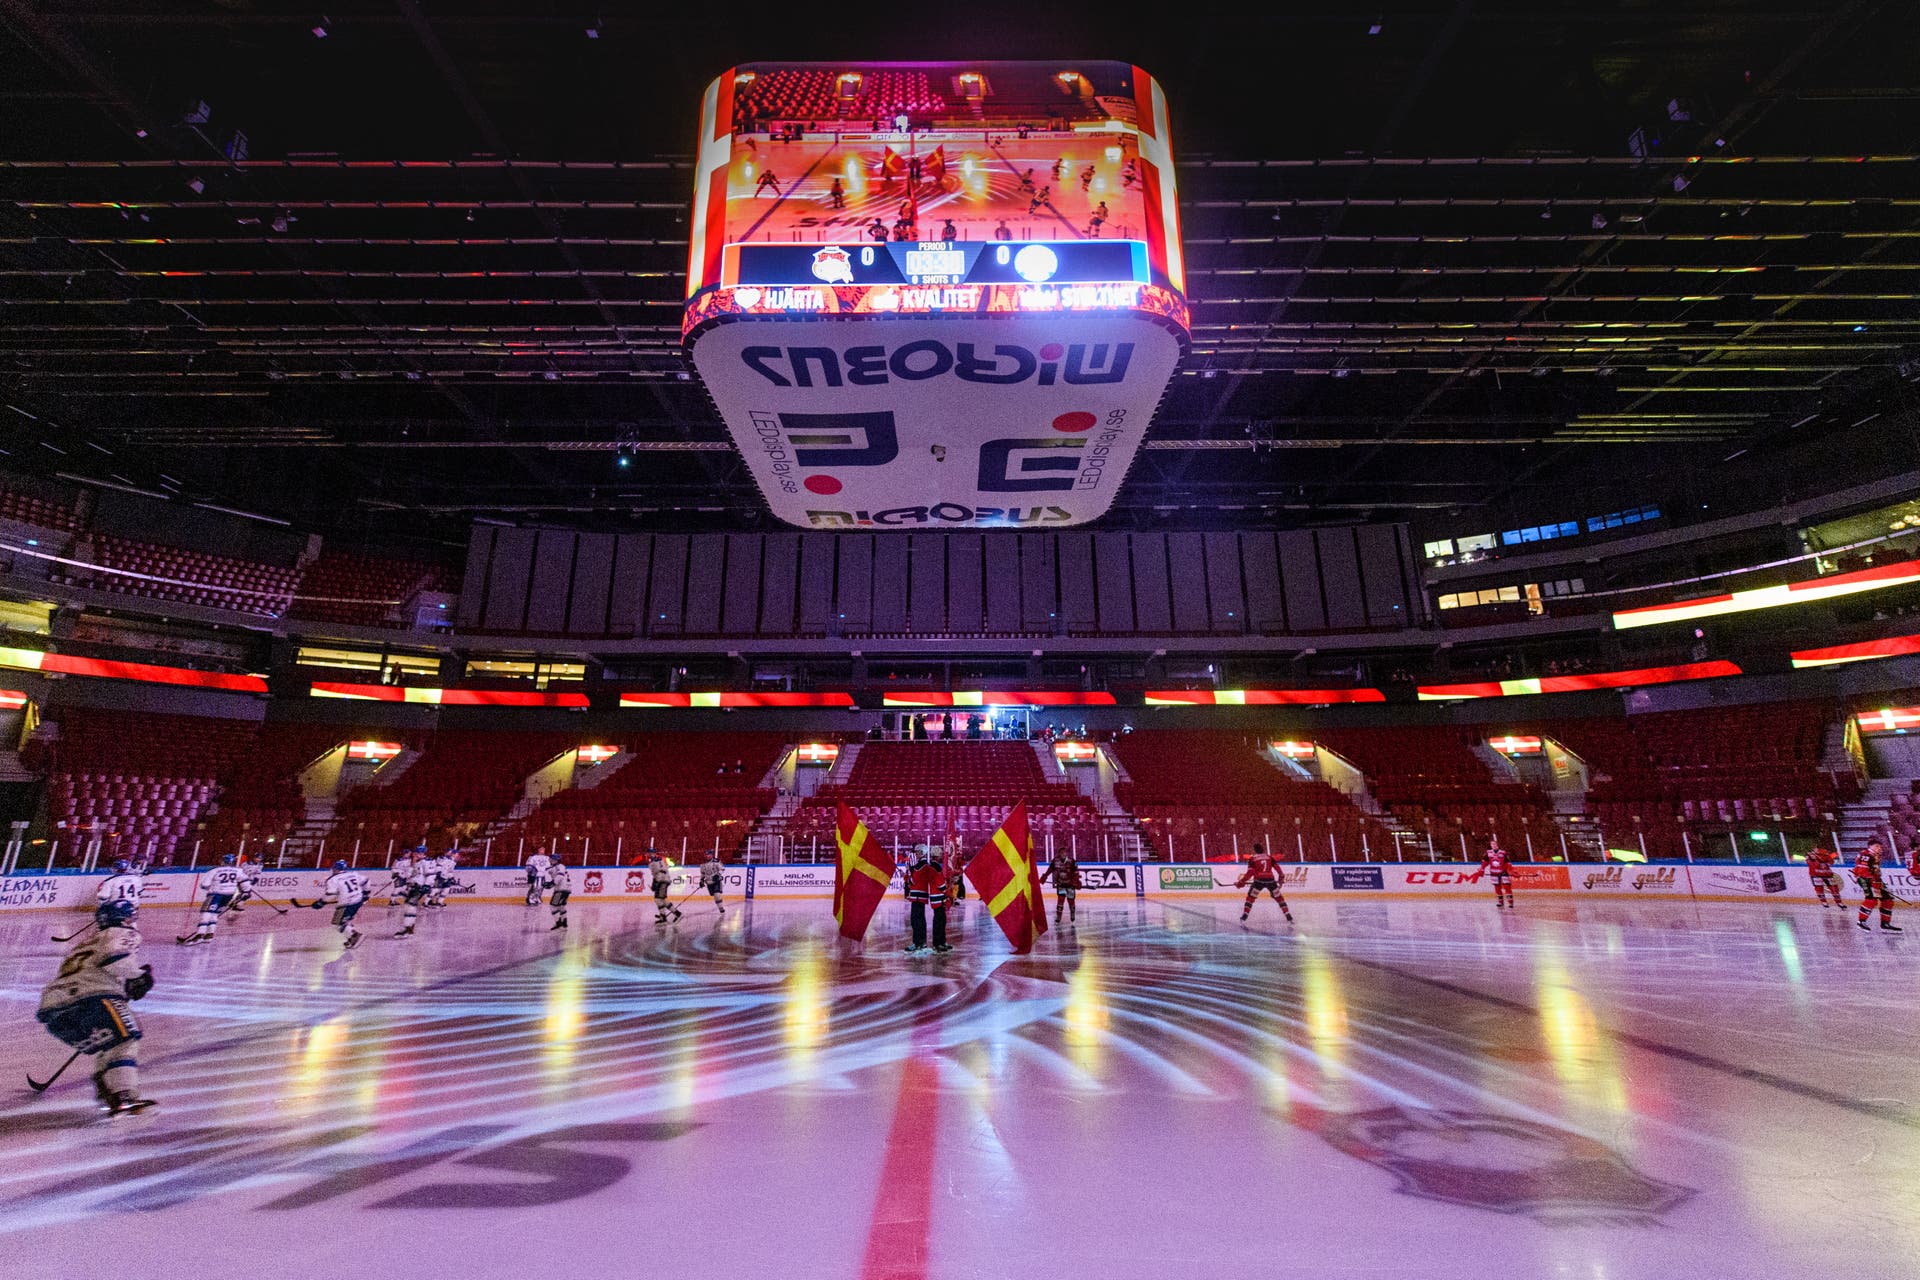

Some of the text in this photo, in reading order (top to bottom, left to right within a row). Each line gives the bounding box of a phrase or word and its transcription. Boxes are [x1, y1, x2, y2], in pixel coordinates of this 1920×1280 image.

[918, 242, 953, 251] PERIOD 1
[861, 246, 875, 266] 0
[997, 245, 1010, 265] 0
[922, 275, 949, 284] SHOTS
[764, 287, 825, 309] HJÄRTA
[902, 288, 978, 309] KVALITET
[1176, 868, 1210, 877] GASAB
[1406, 871, 1481, 884] CCM
[3, 879, 59, 892] EKDAHL
[257, 876, 299, 887] BERGS
[344, 878, 359, 894] 15
[36, 892, 57, 903] AB
[118, 884, 135, 899] 14
